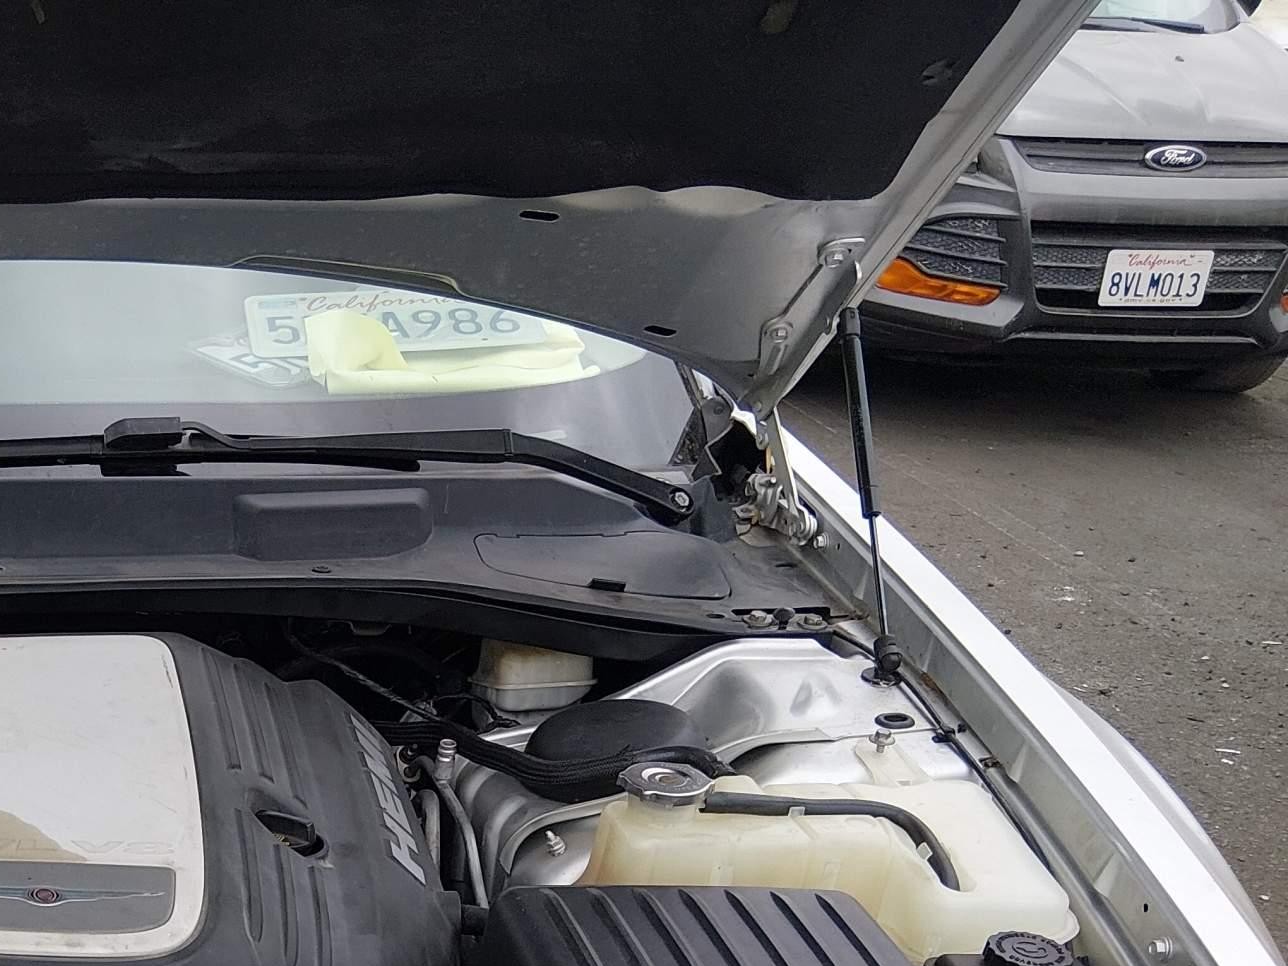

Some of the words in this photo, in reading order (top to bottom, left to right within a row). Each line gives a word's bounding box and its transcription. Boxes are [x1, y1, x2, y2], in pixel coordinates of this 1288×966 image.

[1161, 150, 1196, 166] Ford
[1128, 254, 1192, 270] California
[1108, 271, 1201, 297] 8VLM013
[265, 308, 521, 345] 5A986
[349, 713, 427, 886] HEMI
